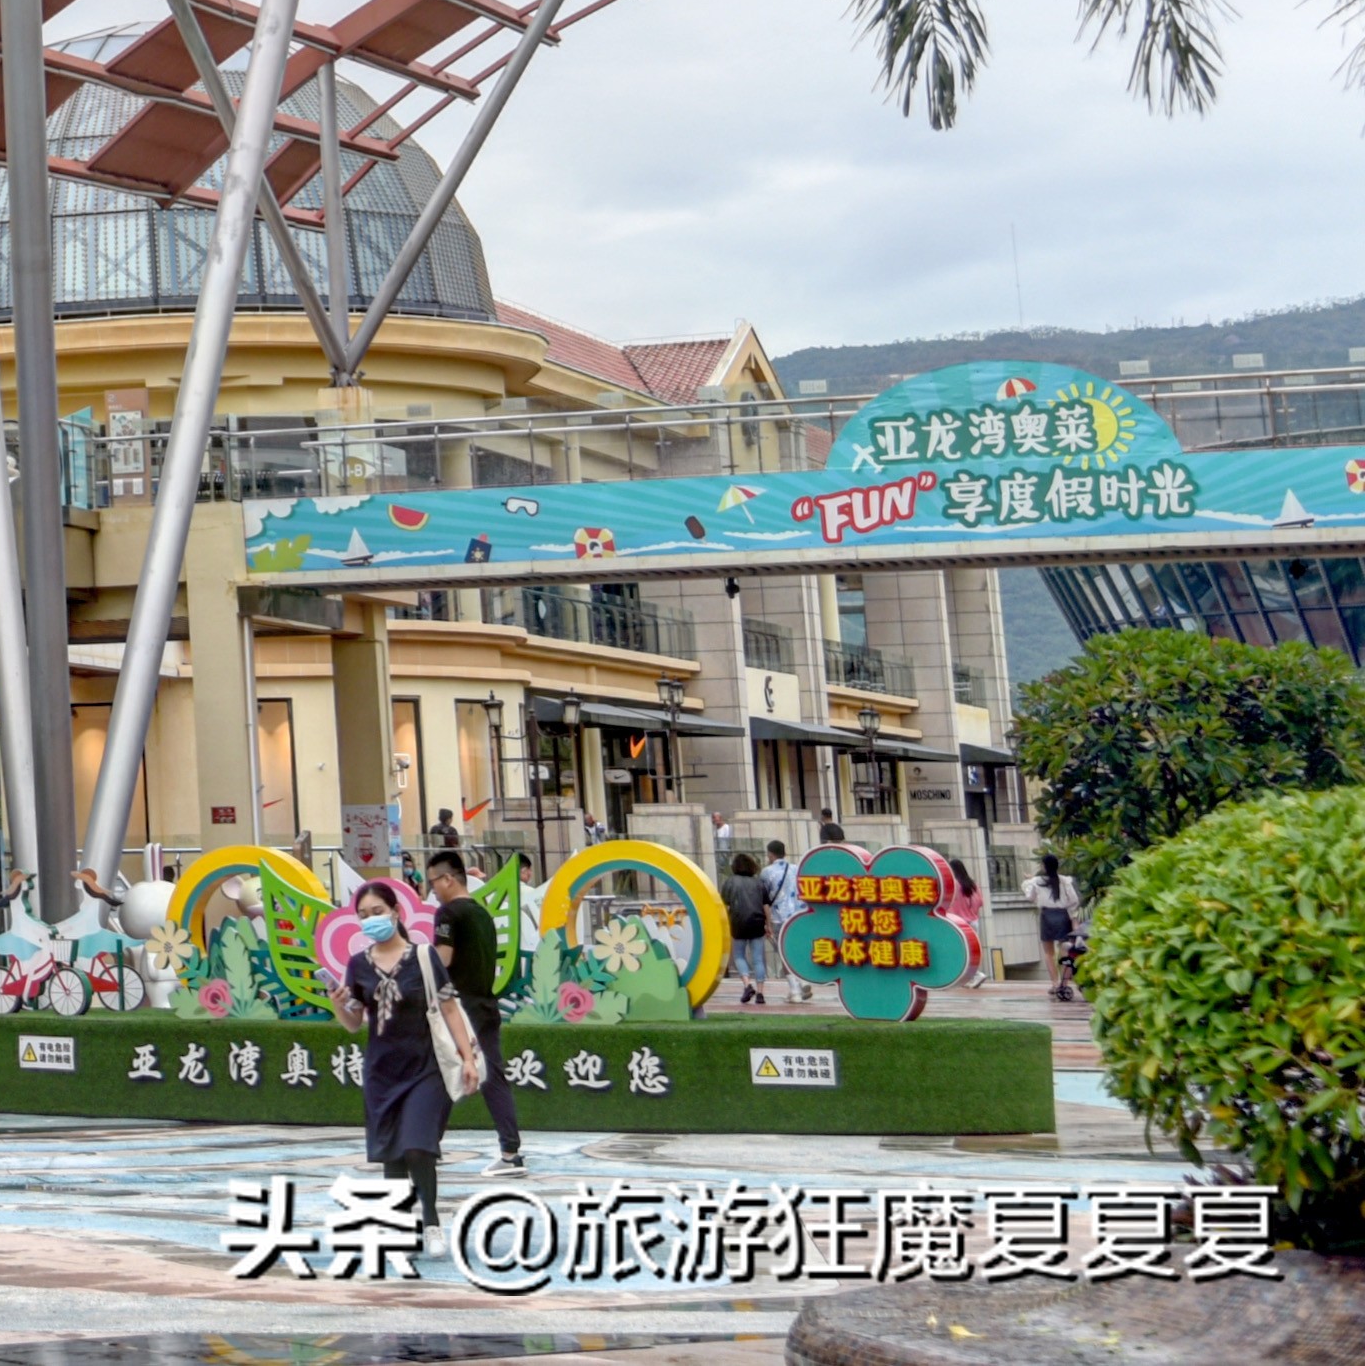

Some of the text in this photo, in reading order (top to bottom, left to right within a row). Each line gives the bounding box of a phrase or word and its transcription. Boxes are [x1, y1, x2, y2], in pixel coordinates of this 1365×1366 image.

[874, 404, 1093, 461] 亚龙湾奥莱
[944, 464, 1193, 522] 享度假时光
[910, 789, 951, 801] MOSCHINO
[798, 876, 936, 903] 亚龙湾奥莱
[840, 908, 898, 934] 祝您
[812, 939, 927, 966] 身体健康
[783, 1055, 829, 1066] 有电危险
